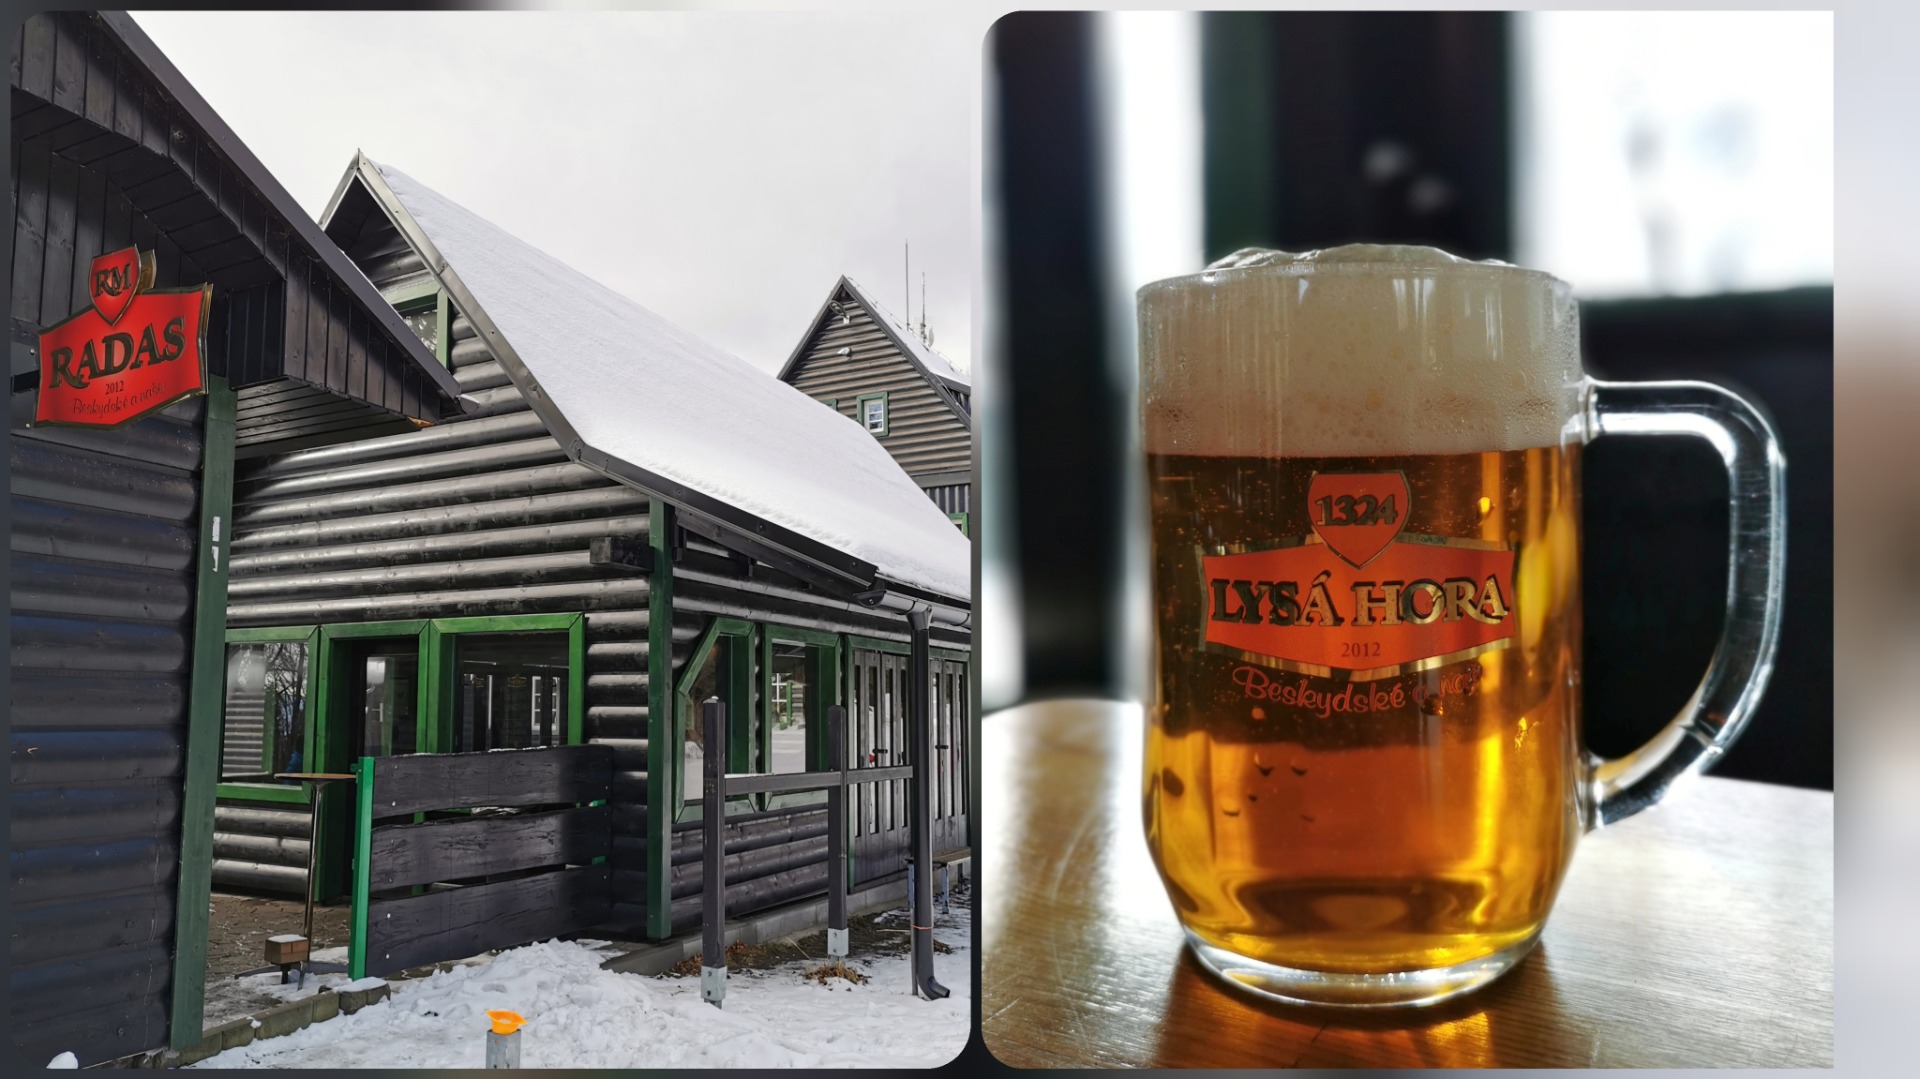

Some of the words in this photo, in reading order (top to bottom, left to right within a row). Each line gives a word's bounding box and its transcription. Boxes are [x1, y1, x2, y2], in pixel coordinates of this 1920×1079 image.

[94, 262, 132, 297] RM
[48, 315, 185, 390] RADAS
[105, 380, 124, 395] 2012
[1315, 494, 1398, 527] 1324
[1210, 570, 1345, 627] LYSÁ
[1351, 573, 1511, 627] HORA
[1341, 642, 1381, 657] 2012
[1232, 666, 1406, 719] Beskydské
